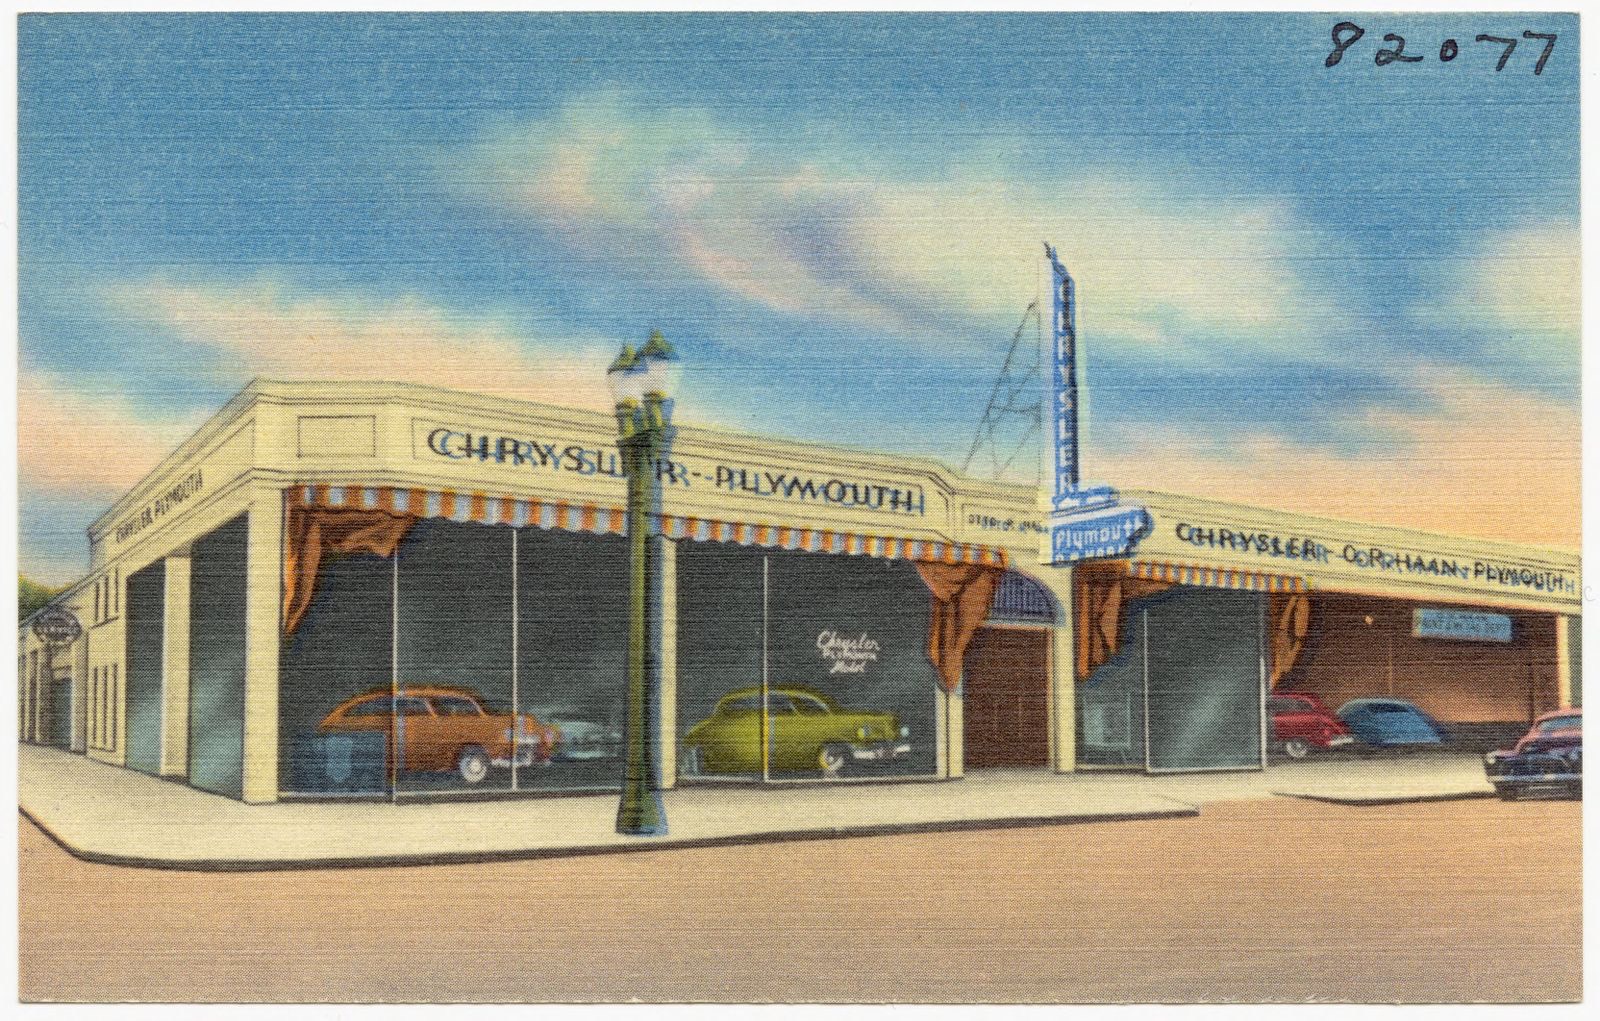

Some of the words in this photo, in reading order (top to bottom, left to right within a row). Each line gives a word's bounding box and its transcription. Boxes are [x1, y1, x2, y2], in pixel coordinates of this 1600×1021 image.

[1325, 21, 1558, 76] 82077
[427, 427, 690, 487] CHRYSLR
[715, 464, 925, 518] PLYMOUTH
[1175, 522, 1329, 564] CHRYSLER
[1474, 561, 1575, 594] PLYMOUTH
